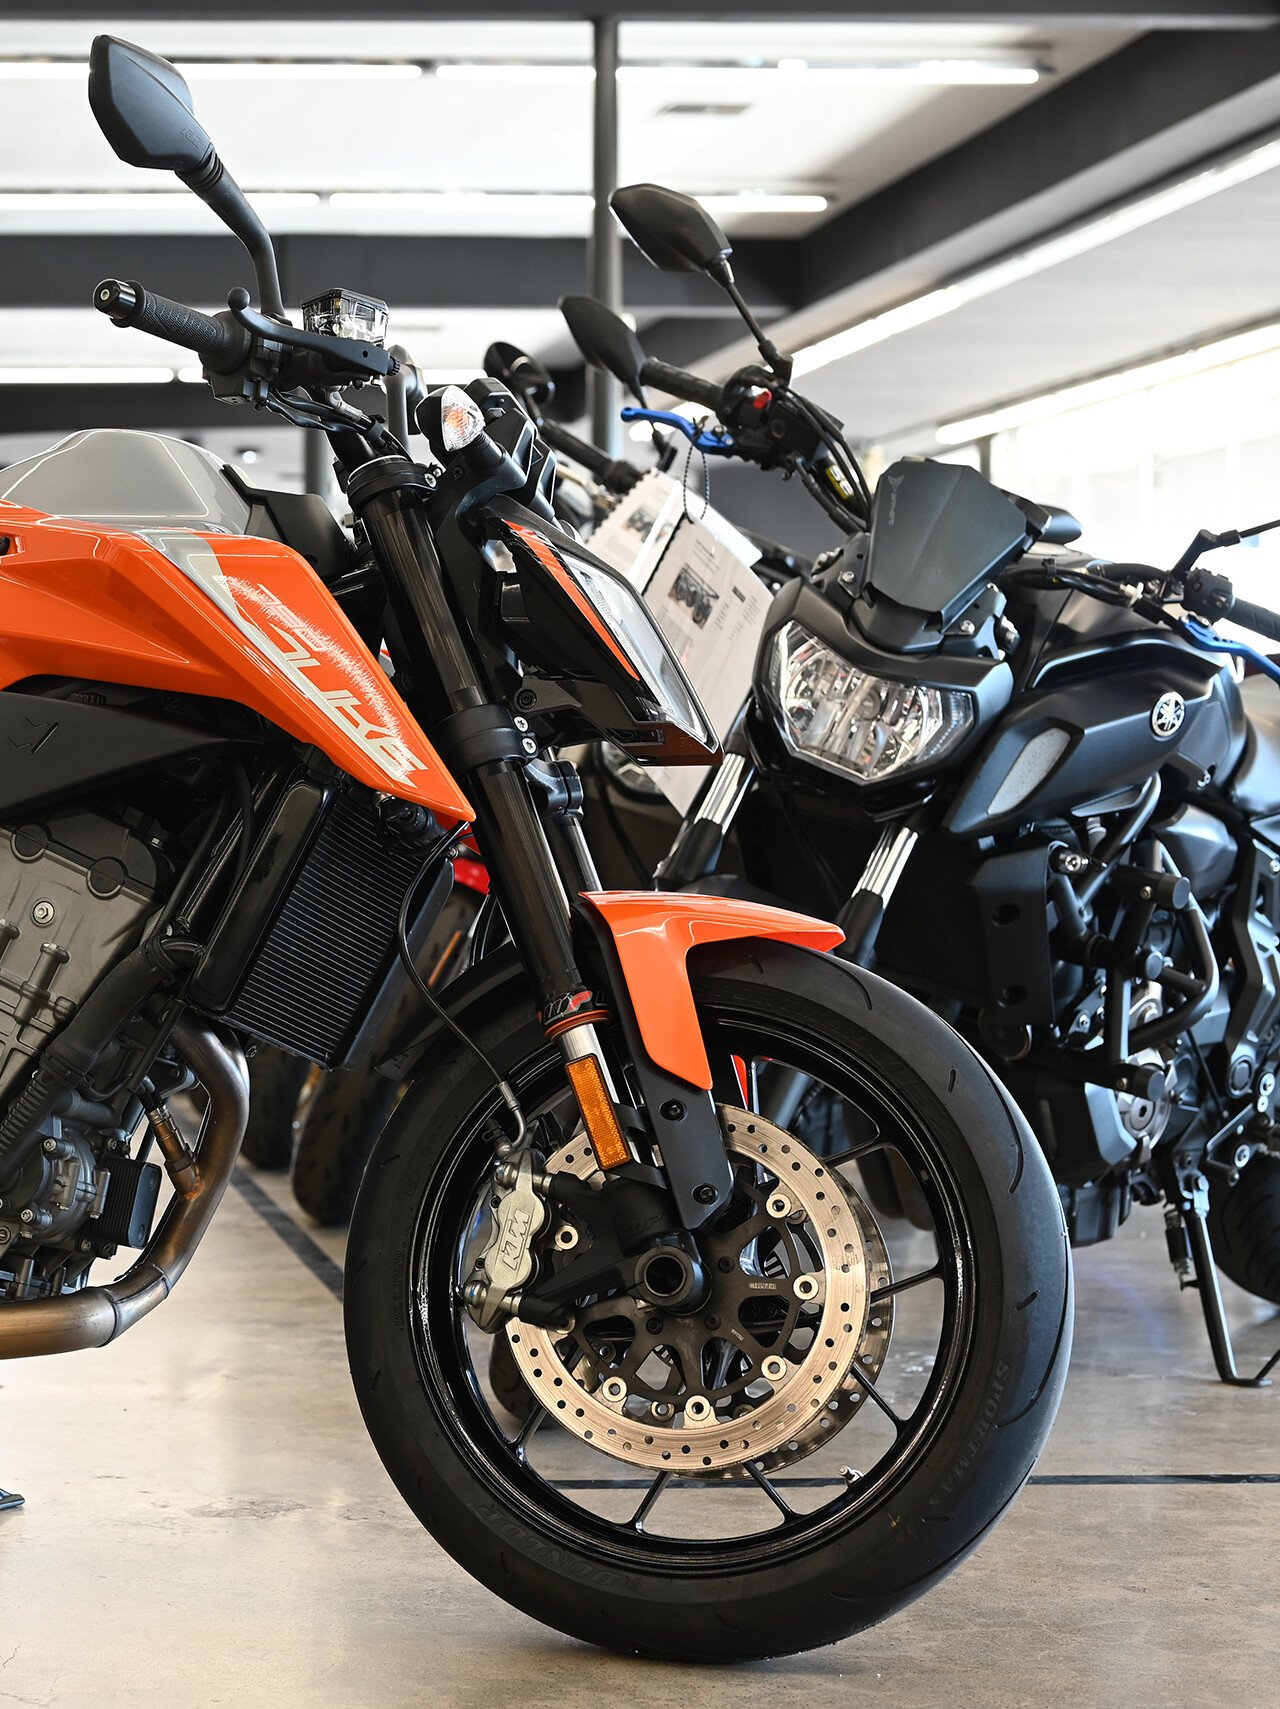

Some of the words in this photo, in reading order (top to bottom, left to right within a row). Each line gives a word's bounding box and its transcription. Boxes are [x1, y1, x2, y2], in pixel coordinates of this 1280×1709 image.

[267, 622, 429, 789] DUKE
[503, 1208, 531, 1271] KTM
[476, 1504, 621, 1586] DUNLOP
